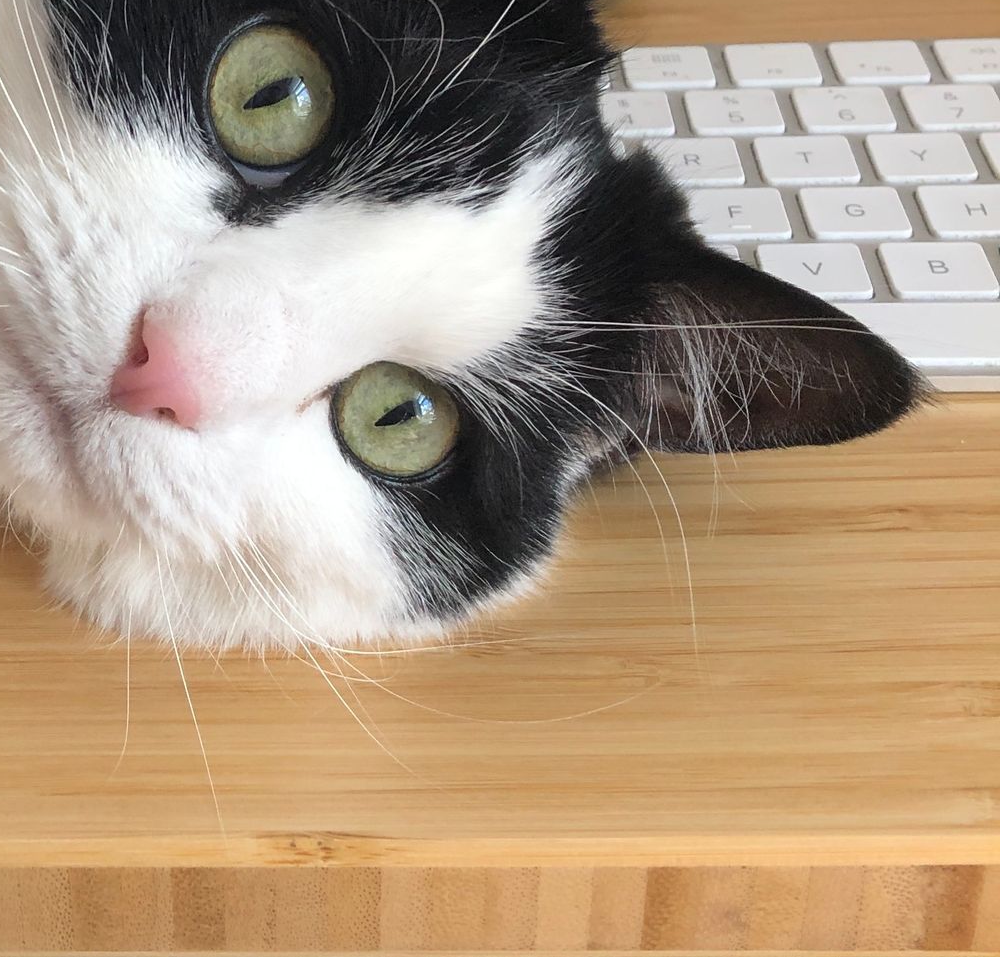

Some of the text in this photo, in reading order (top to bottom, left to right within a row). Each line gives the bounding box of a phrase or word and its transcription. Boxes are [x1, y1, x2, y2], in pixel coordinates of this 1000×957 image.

[728, 110, 744, 123] 5
[838, 108, 855, 121] 6
[948, 106, 964, 119] 7
[683, 153, 700, 165] R
[795, 151, 813, 164] T
[910, 149, 927, 162] Y
[727, 205, 743, 218] F
[844, 203, 865, 217] G
[965, 203, 988, 216] H
[802, 261, 823, 276] V
[927, 259, 950, 274] B
